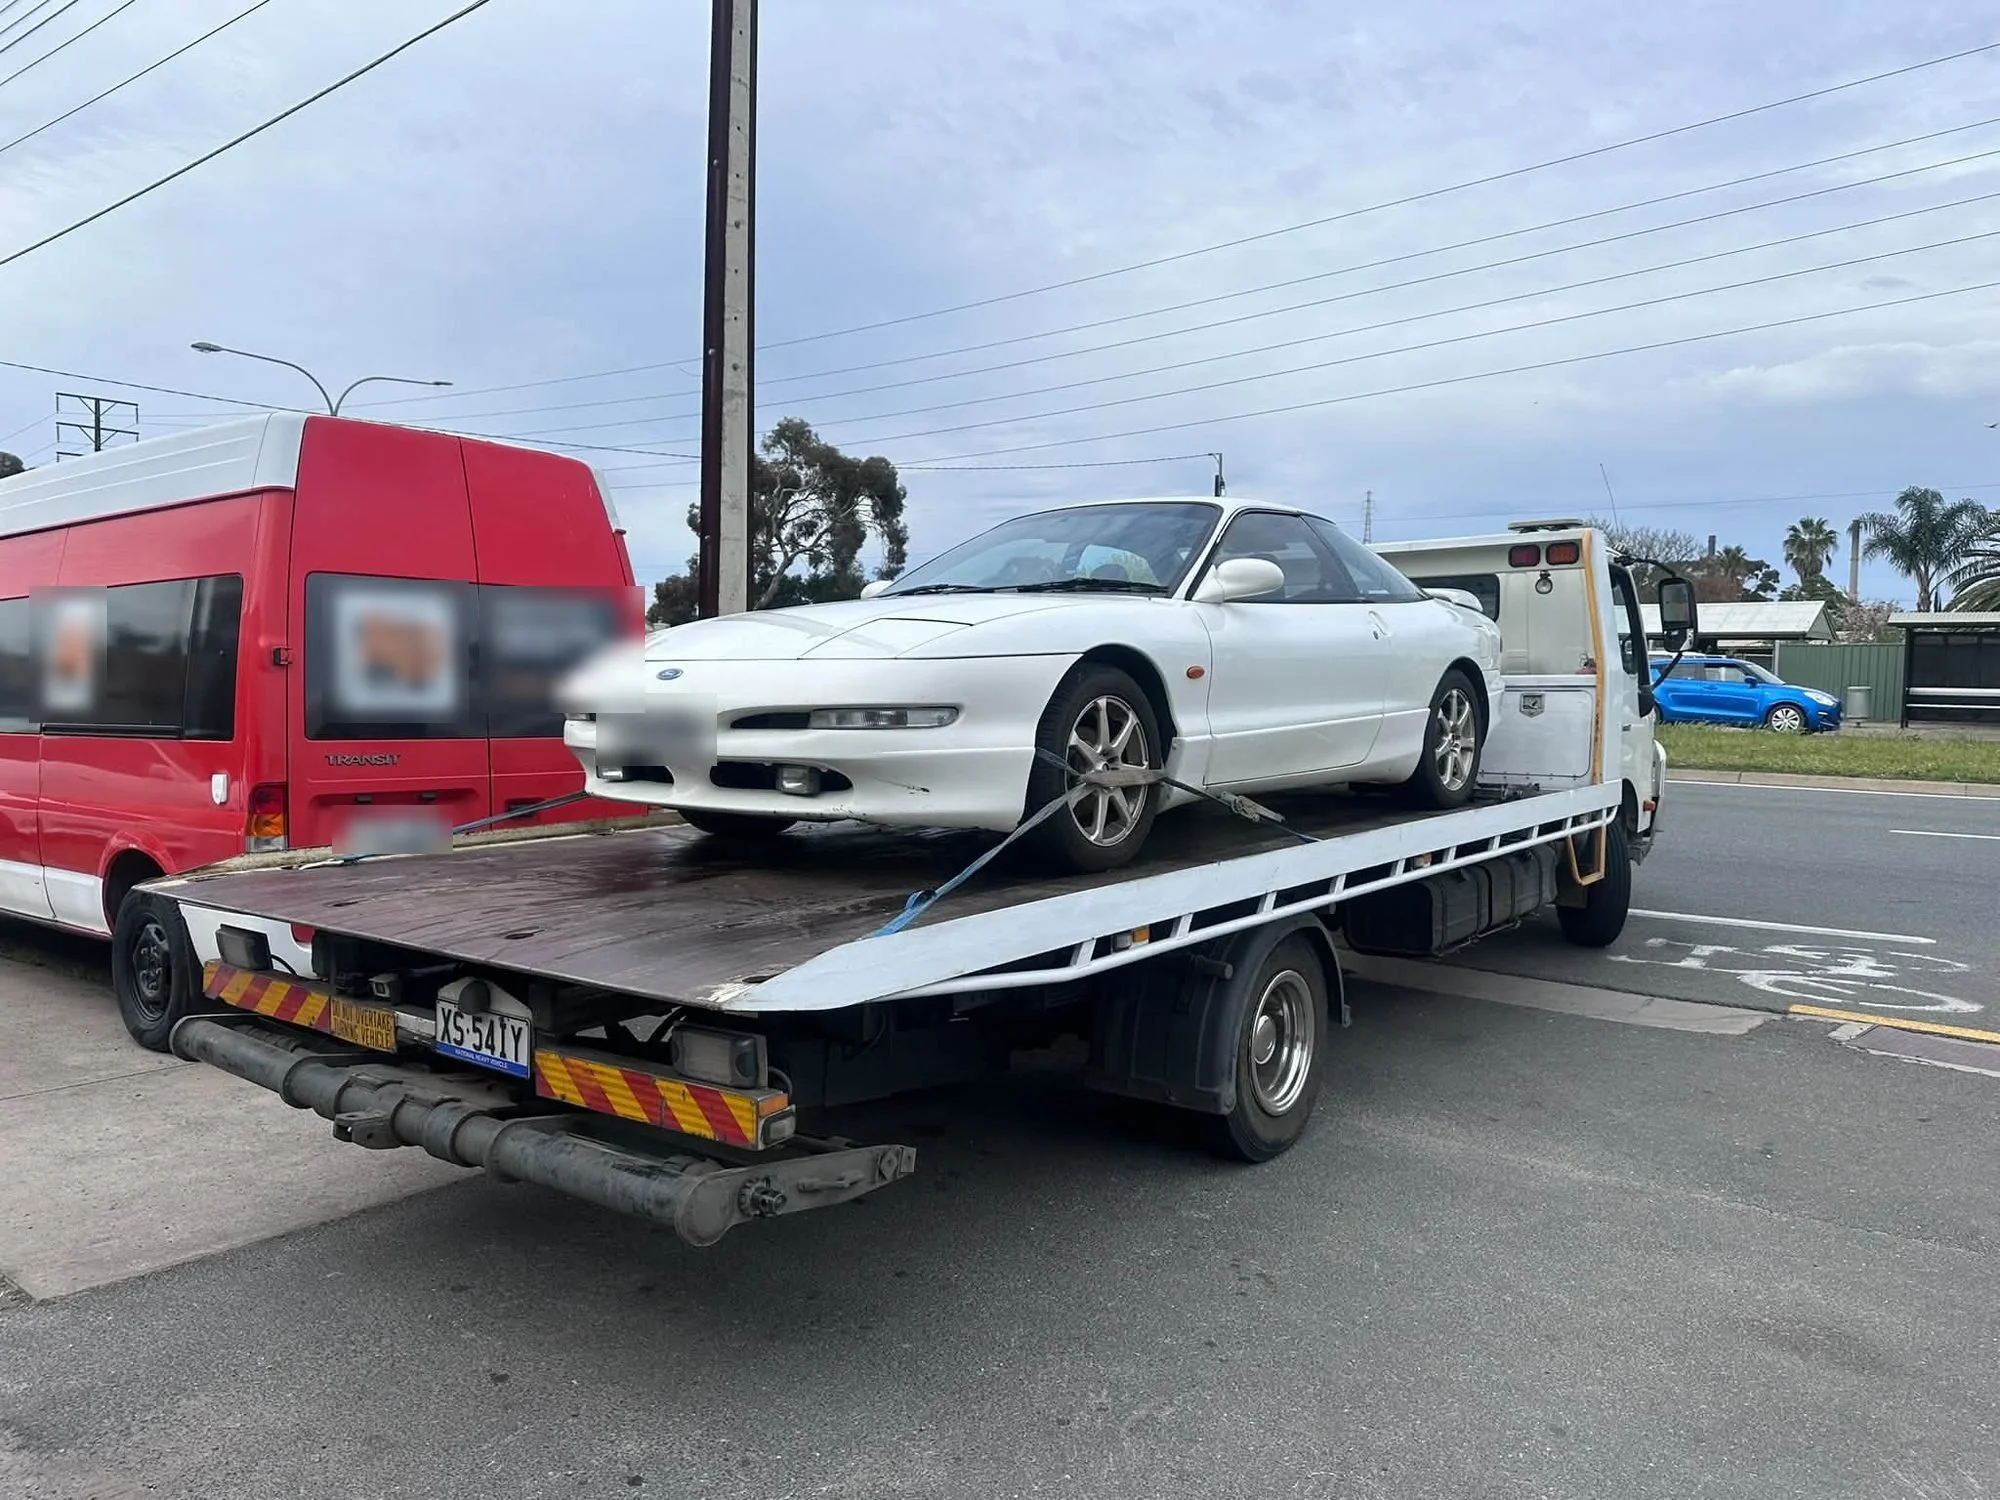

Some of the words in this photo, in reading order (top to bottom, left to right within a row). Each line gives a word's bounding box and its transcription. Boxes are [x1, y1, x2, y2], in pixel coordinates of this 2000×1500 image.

[325, 754, 400, 766] TRANSIT
[355, 1007, 393, 1032] OVERTAKE
[361, 1025, 391, 1049] VEHICLE
